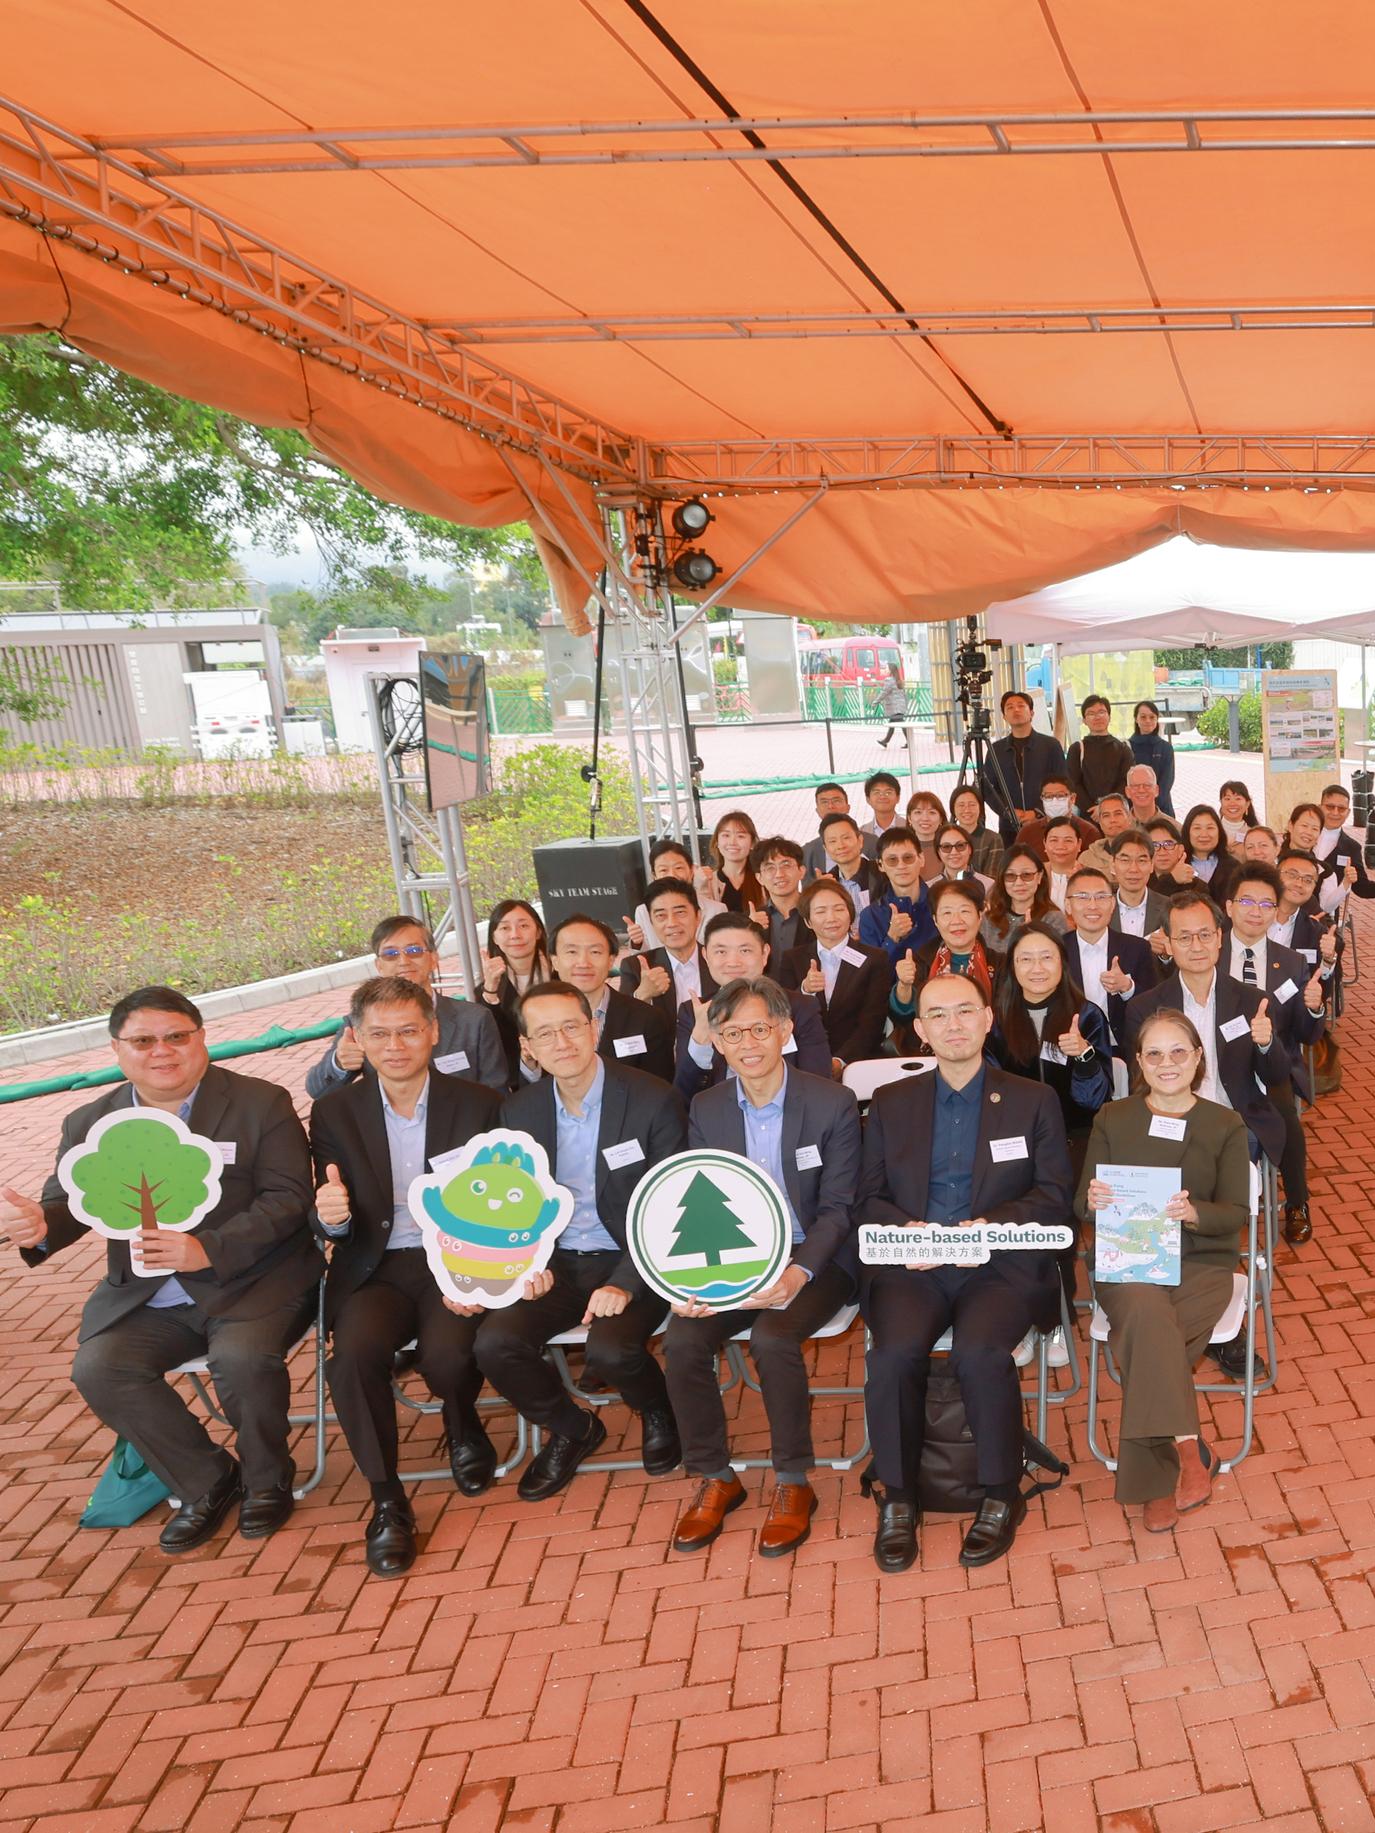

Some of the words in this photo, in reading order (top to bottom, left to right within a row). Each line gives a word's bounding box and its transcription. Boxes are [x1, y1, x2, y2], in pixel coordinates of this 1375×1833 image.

[567, 887, 590, 897] TEAM
[864, 1230, 982, 1244] Nature-based
[986, 1230, 1066, 1244] Solutions
[865, 1246, 984, 1259] 基於自然的解決方案
